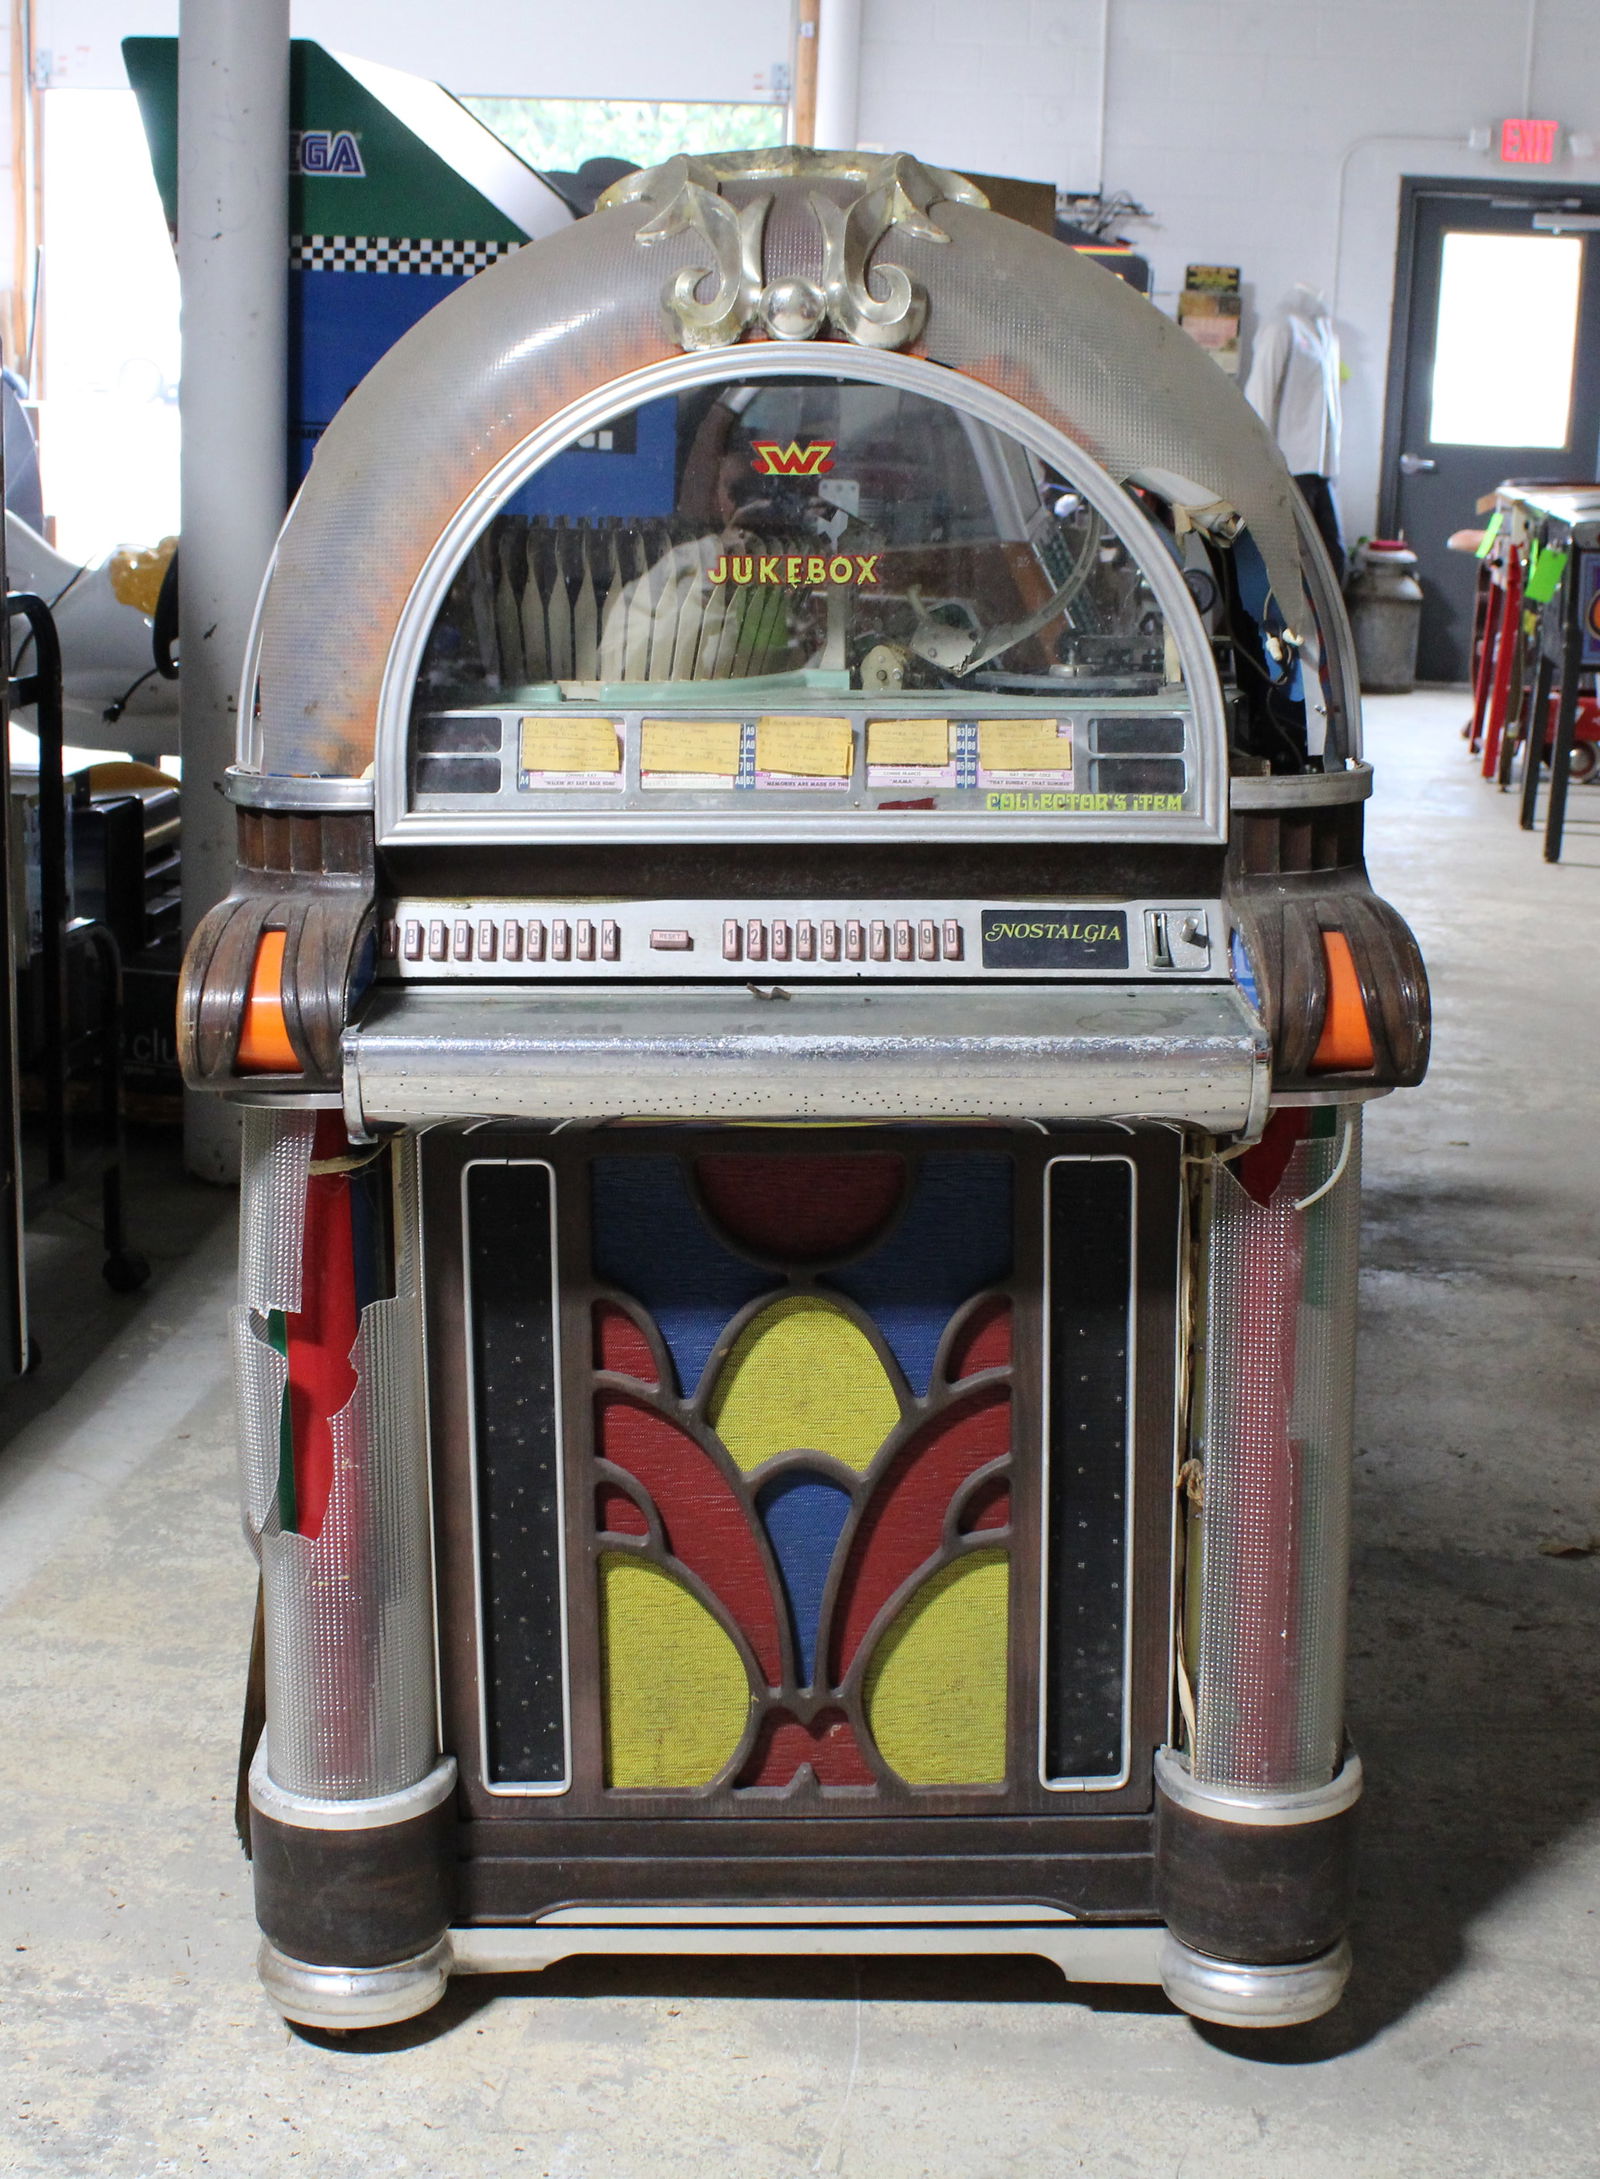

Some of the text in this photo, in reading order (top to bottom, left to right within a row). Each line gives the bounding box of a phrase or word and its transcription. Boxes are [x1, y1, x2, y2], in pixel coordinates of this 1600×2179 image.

[1501, 118, 1559, 164] EXIT
[707, 555, 882, 586] JUKEBOX
[986, 792, 1127, 812] COLLECTOR'S
[407, 928, 416, 945] B
[432, 928, 440, 945] C
[457, 928, 465, 944] D
[481, 928, 489, 945] E
[507, 928, 515, 945] F
[530, 928, 538, 946] G
[555, 928, 563, 945] H
[579, 928, 588, 944] J
[604, 928, 613, 945] K
[727, 928, 734, 944] 1
[751, 928, 759, 944] 2
[775, 928, 784, 944] 3
[800, 928, 810, 944] 4
[825, 929, 833, 945] 5
[850, 928, 858, 944] 6
[875, 929, 883, 945] 7
[899, 929, 907, 945] 8
[924, 928, 932, 944] 9
[948, 929, 955, 945] 0
[985, 923, 1121, 943] NOSTALGIA
